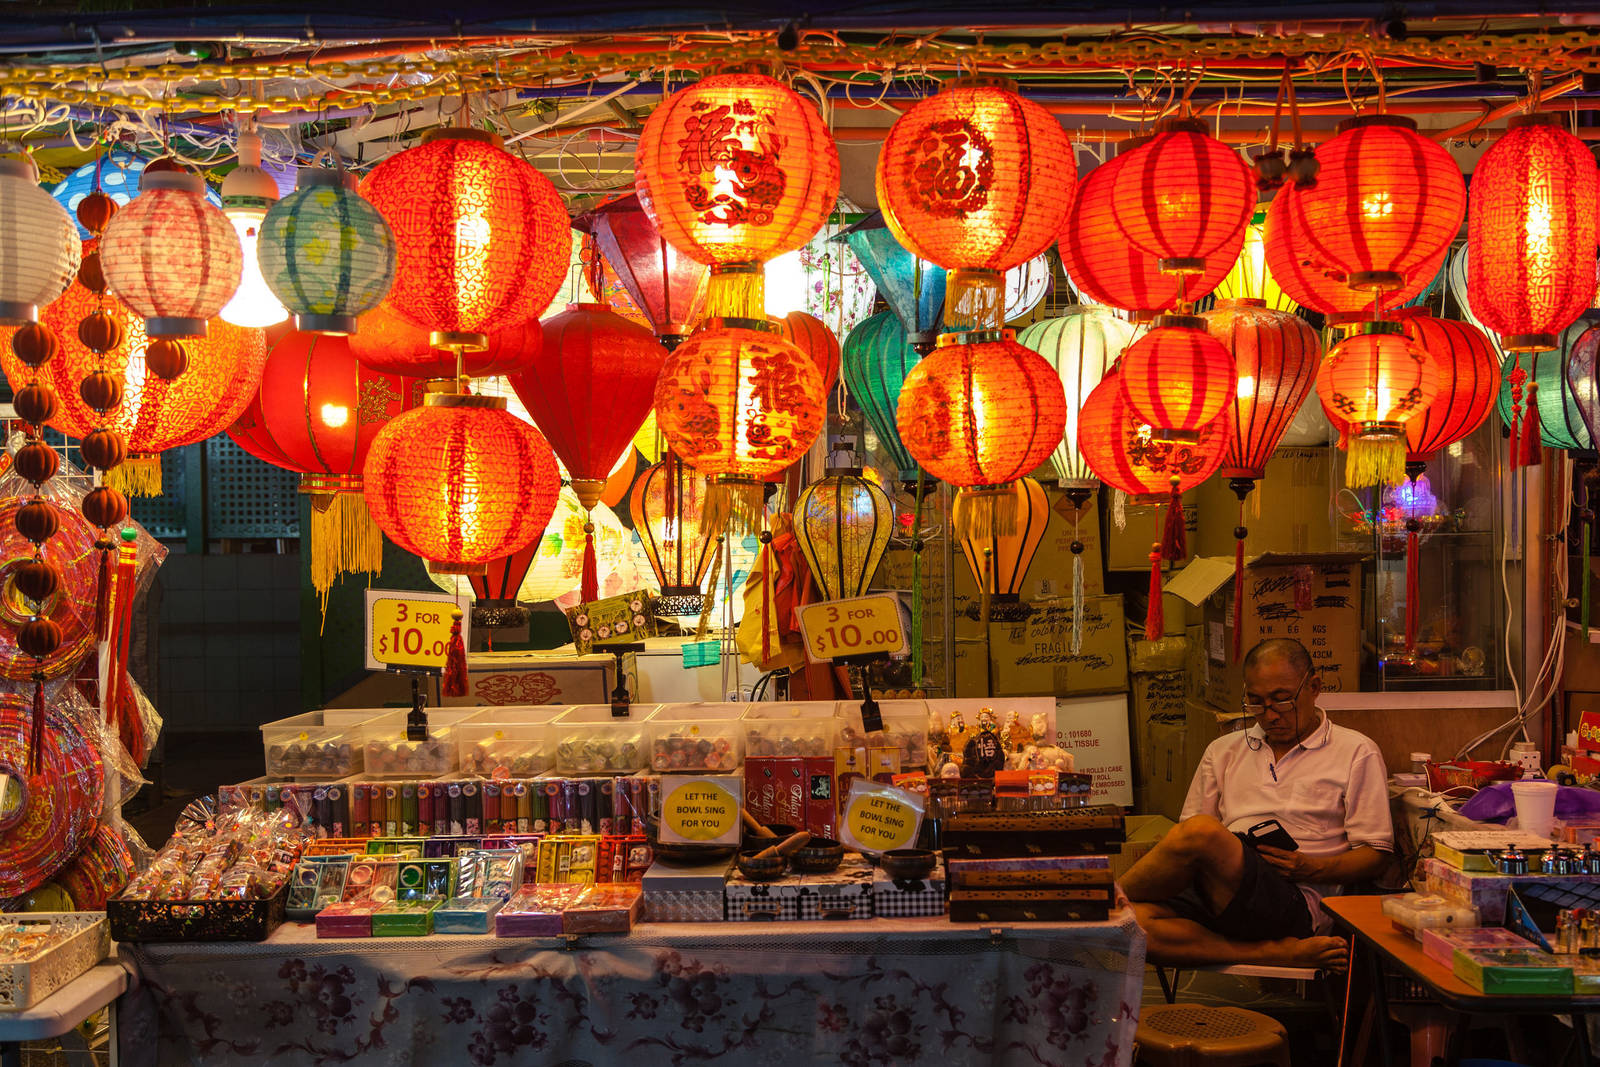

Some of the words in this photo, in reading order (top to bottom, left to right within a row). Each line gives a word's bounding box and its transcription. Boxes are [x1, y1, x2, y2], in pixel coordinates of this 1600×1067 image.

[396, 603, 408, 622] 3
[415, 612, 441, 624] FOR
[826, 607, 840, 622] 3
[847, 608, 875, 620] FOR
[1312, 625, 1327, 634] KGS
[816, 624, 898, 653] $10.00
[1312, 637, 1327, 646] KGS
[1034, 642, 1074, 655] FRAGIL
[1075, 739, 1099, 747] TISSUE
[685, 792, 699, 800] LET
[702, 792, 718, 800] THE
[676, 806, 702, 814] BOWL
[704, 806, 726, 815] SING
[870, 798, 885, 808] LET
[886, 802, 901, 812] THE
[681, 819, 699, 828] FOR
[701, 819, 720, 828] YOU
[859, 810, 883, 823] BOWL
[884, 816, 905, 829] SING
[860, 824, 877, 835] FOR
[878, 828, 896, 840] YOU
